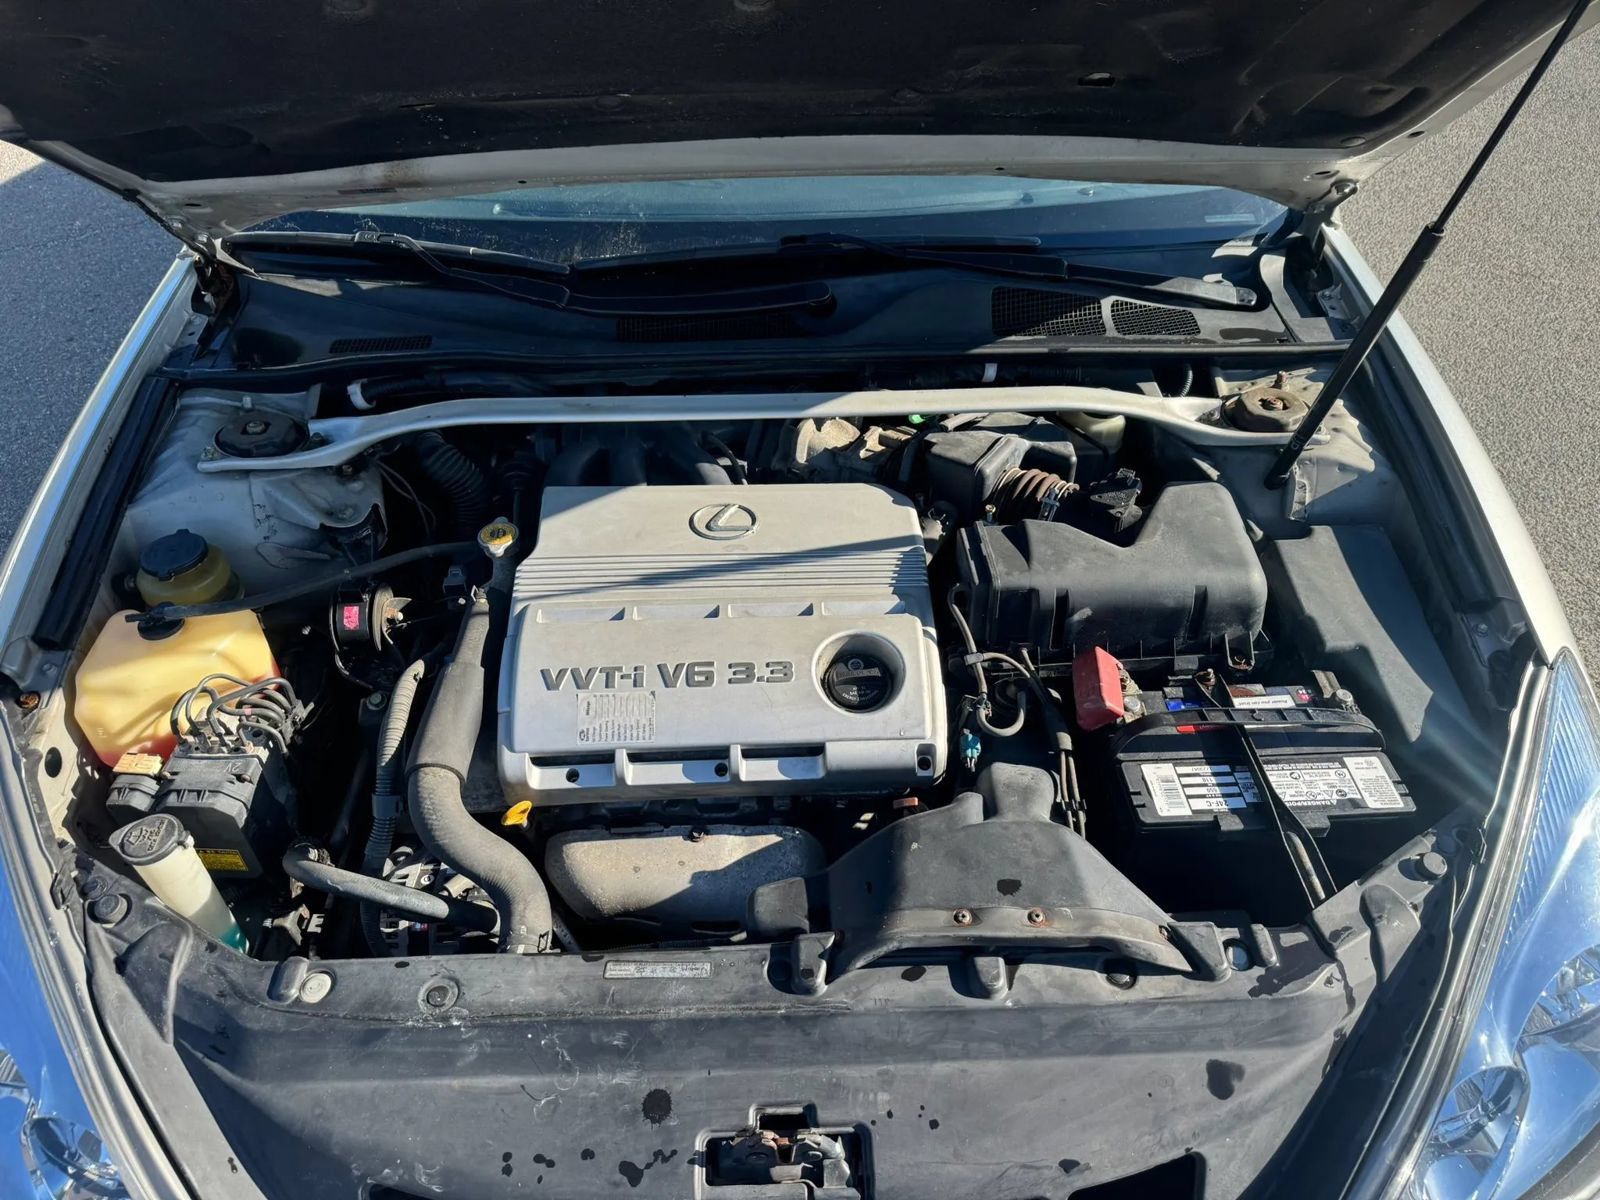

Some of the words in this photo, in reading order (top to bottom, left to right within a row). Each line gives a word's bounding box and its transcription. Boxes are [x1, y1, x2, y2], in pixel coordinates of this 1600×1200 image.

[540, 665, 646, 691] VVT-i
[657, 661, 717, 689] V6
[728, 661, 796, 685] 3.3
